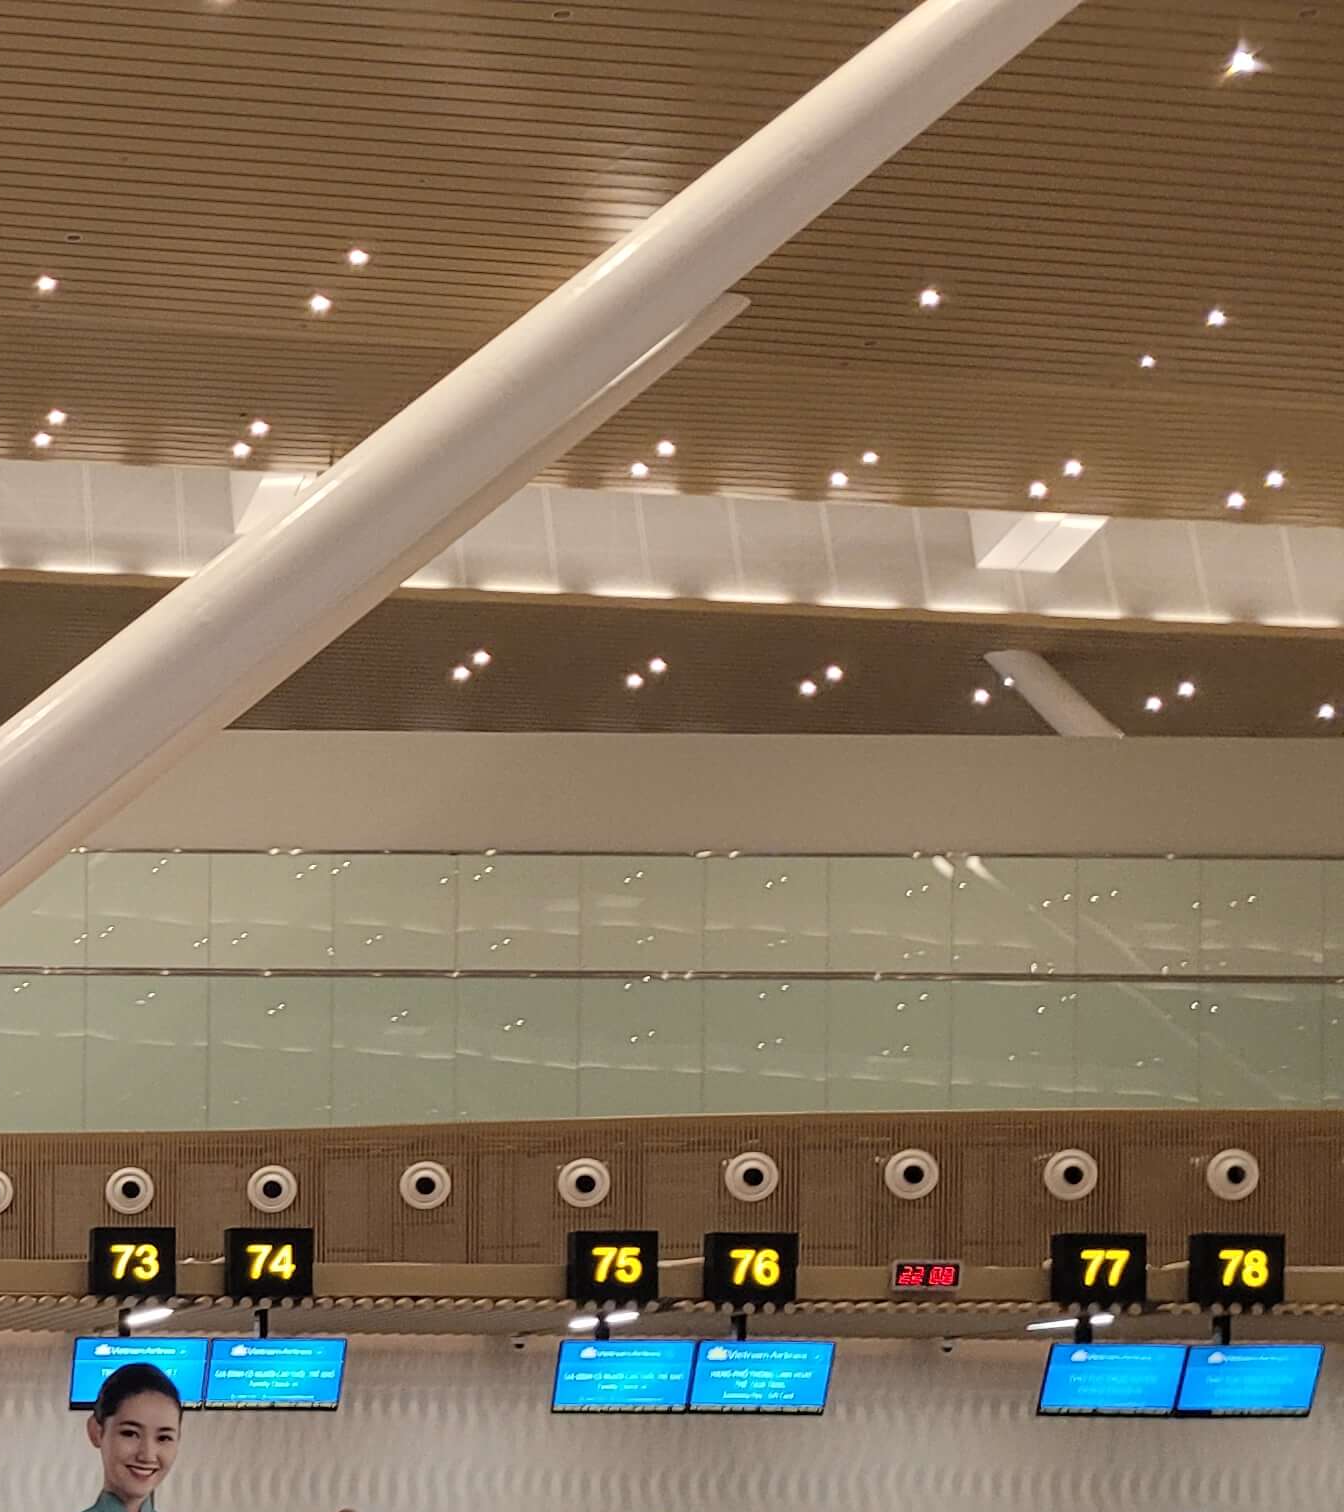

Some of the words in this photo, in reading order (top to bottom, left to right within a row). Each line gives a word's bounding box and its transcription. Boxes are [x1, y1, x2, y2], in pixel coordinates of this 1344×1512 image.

[110, 1244, 160, 1280] 73
[246, 1244, 297, 1280] 74
[591, 1246, 642, 1283] 75
[730, 1248, 780, 1286] 76
[1080, 1249, 1130, 1287] 77
[1218, 1249, 1269, 1288] 78
